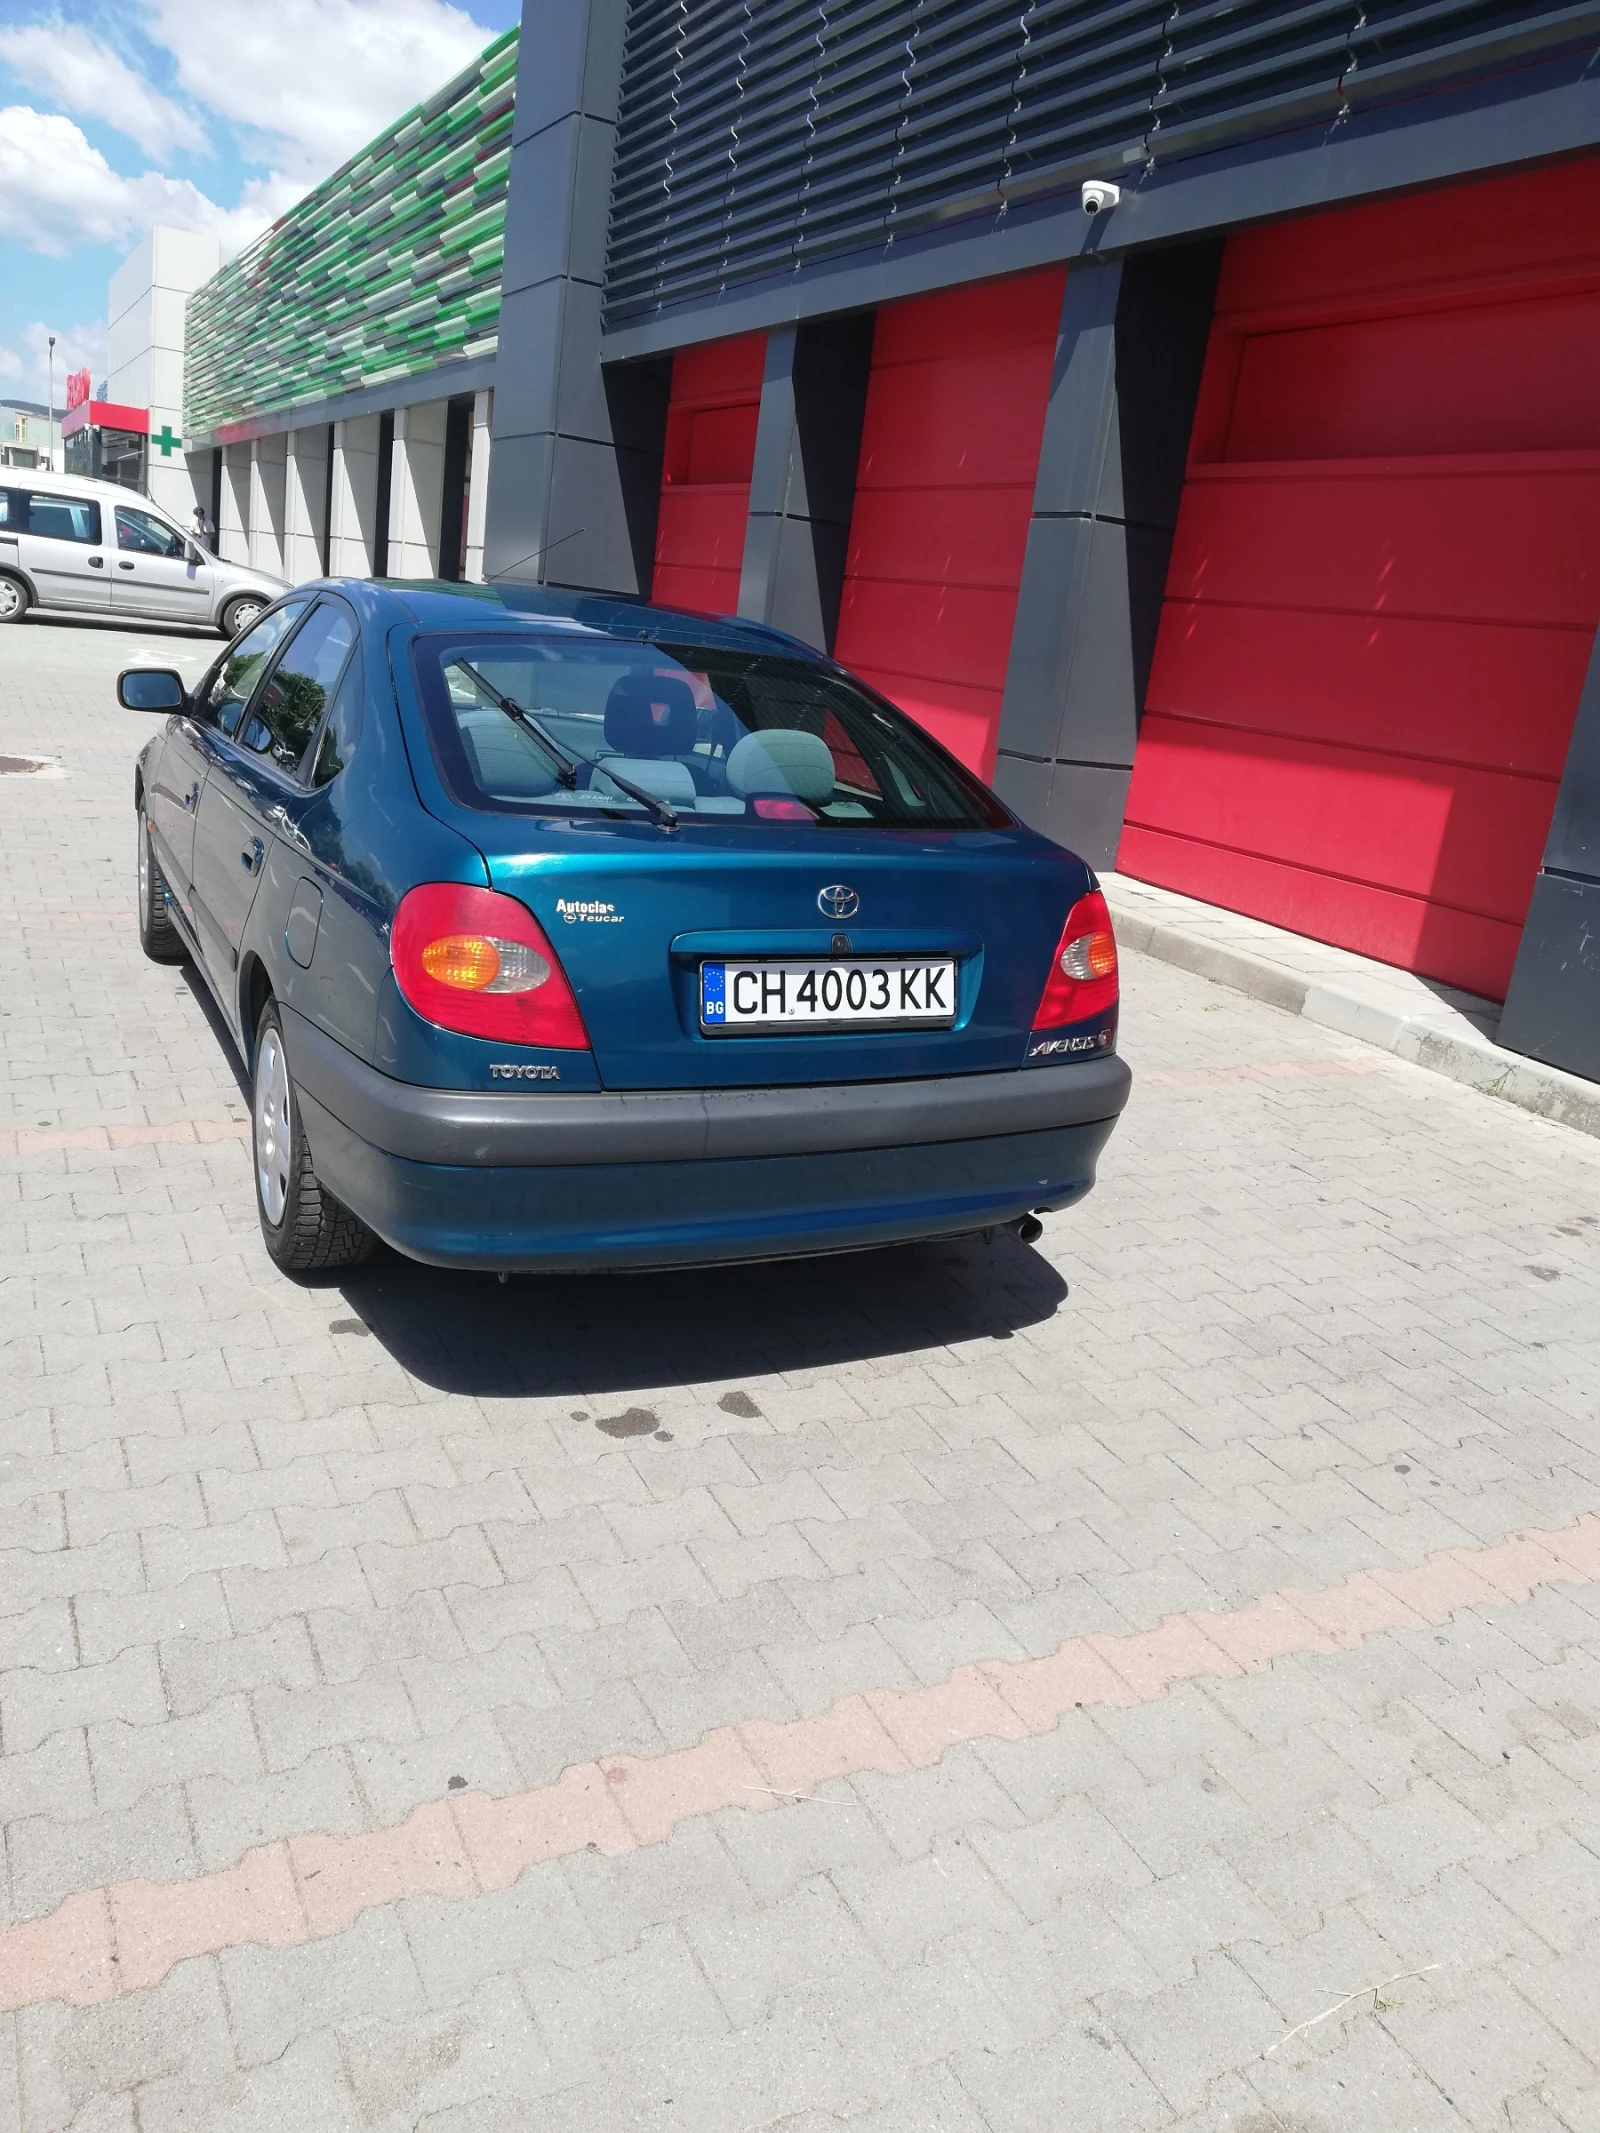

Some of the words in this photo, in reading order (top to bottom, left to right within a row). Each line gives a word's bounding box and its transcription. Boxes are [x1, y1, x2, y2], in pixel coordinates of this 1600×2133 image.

[578, 913, 625, 923] Teucar
[706, 1001, 724, 1016] BG
[1029, 1036, 1097, 1057] AVENSIS
[489, 1064, 561, 1080] TOYOTA
